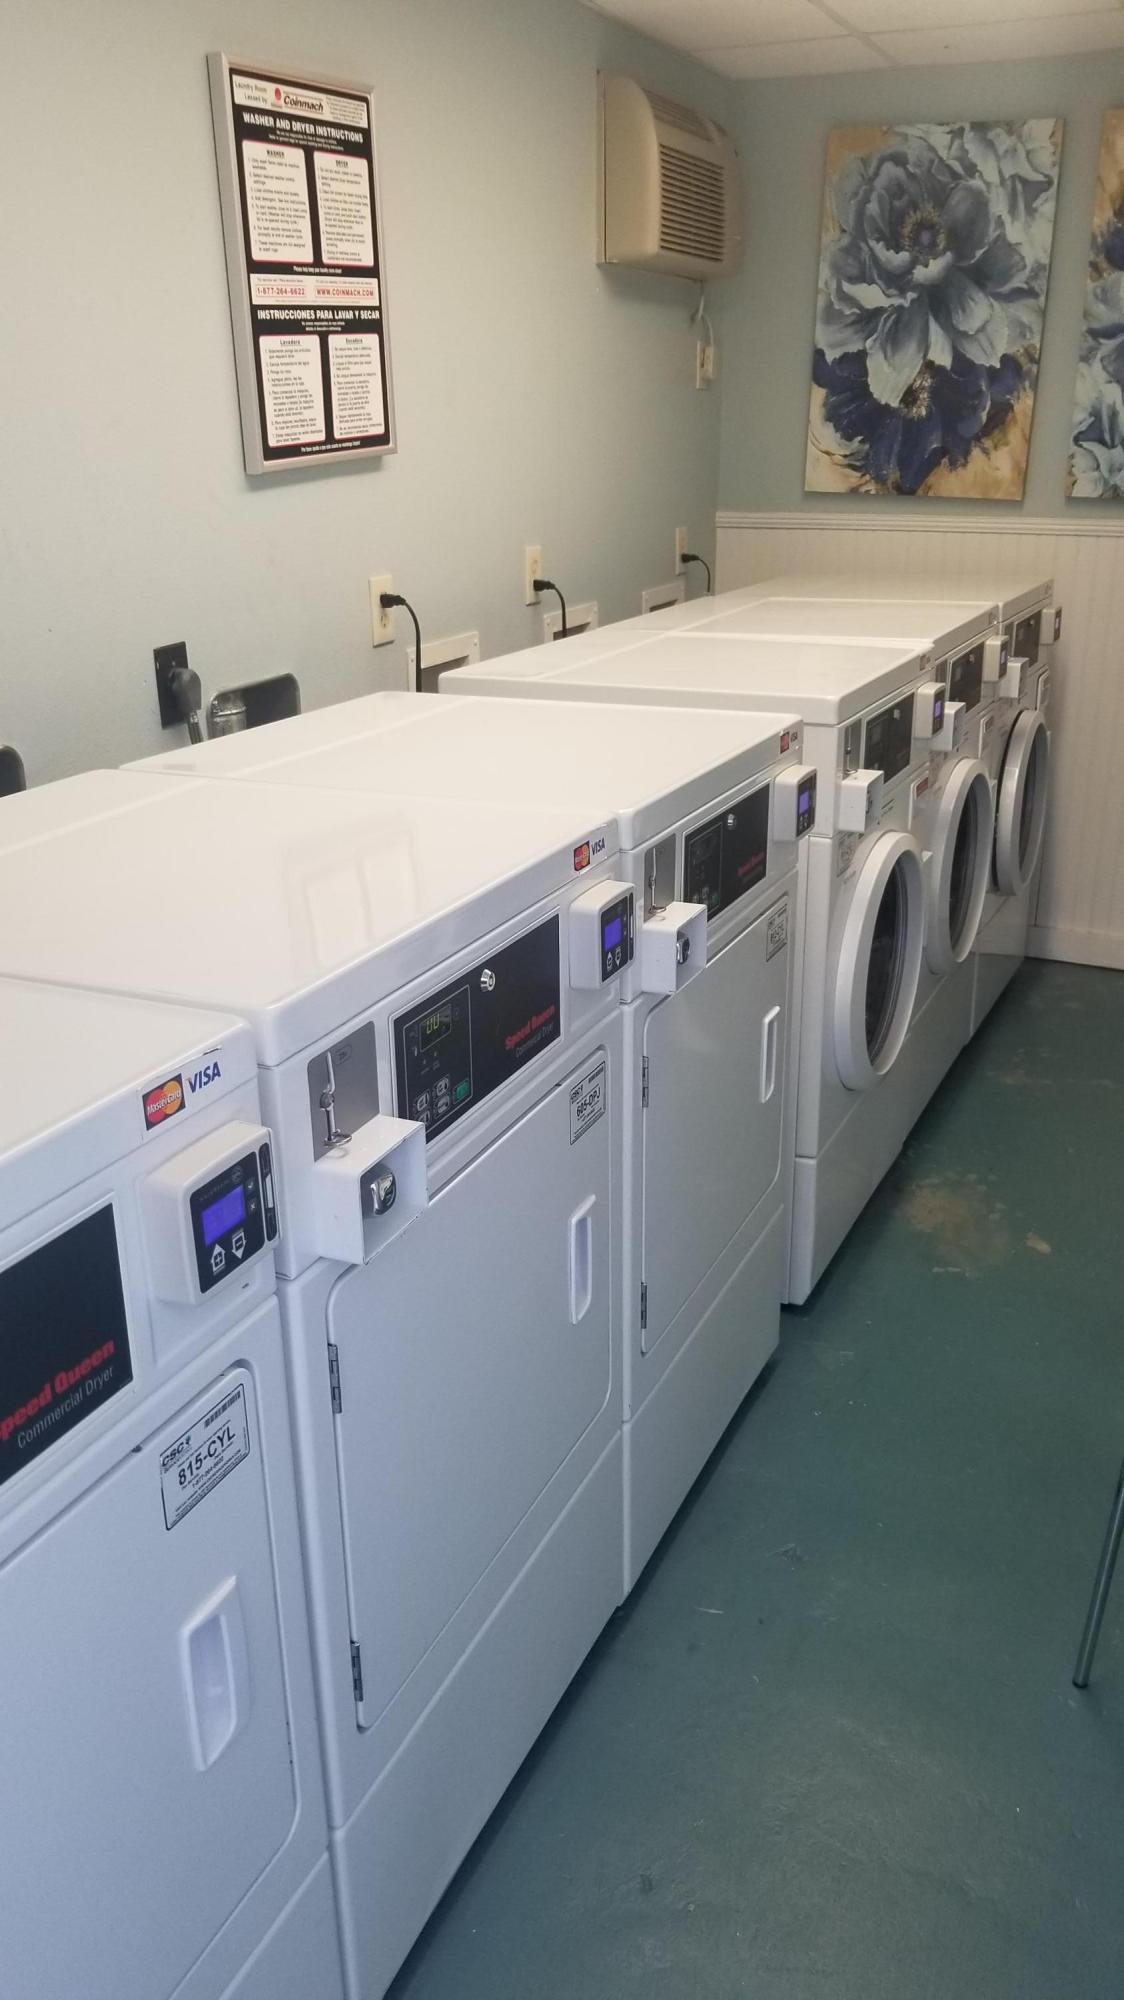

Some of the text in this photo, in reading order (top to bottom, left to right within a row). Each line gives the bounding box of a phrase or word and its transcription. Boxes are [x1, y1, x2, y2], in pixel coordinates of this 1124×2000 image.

[283, 95, 324, 112] Coinmach
[243, 111, 275, 127] WASHER
[276, 117, 291, 131] AND
[291, 120, 315, 135] DRYER
[315, 125, 364, 143] INSTRUCTIONS
[316, 287, 375, 297] WWW.COINMACH.COM
[257, 309, 380, 320] INSTRUCCIONES PARA LAVAR Y SECAR
[591, 837, 606, 856] VISA
[188, 1061, 222, 1093] VISA
[147, 1089, 181, 1116] MasterCard
[0, 1340, 115, 1441] peed Queen
[17, 1366, 114, 1449] Commercial Dryer
[162, 1441, 184, 1467] CSC
[178, 1425, 236, 1486] 815-CYL
